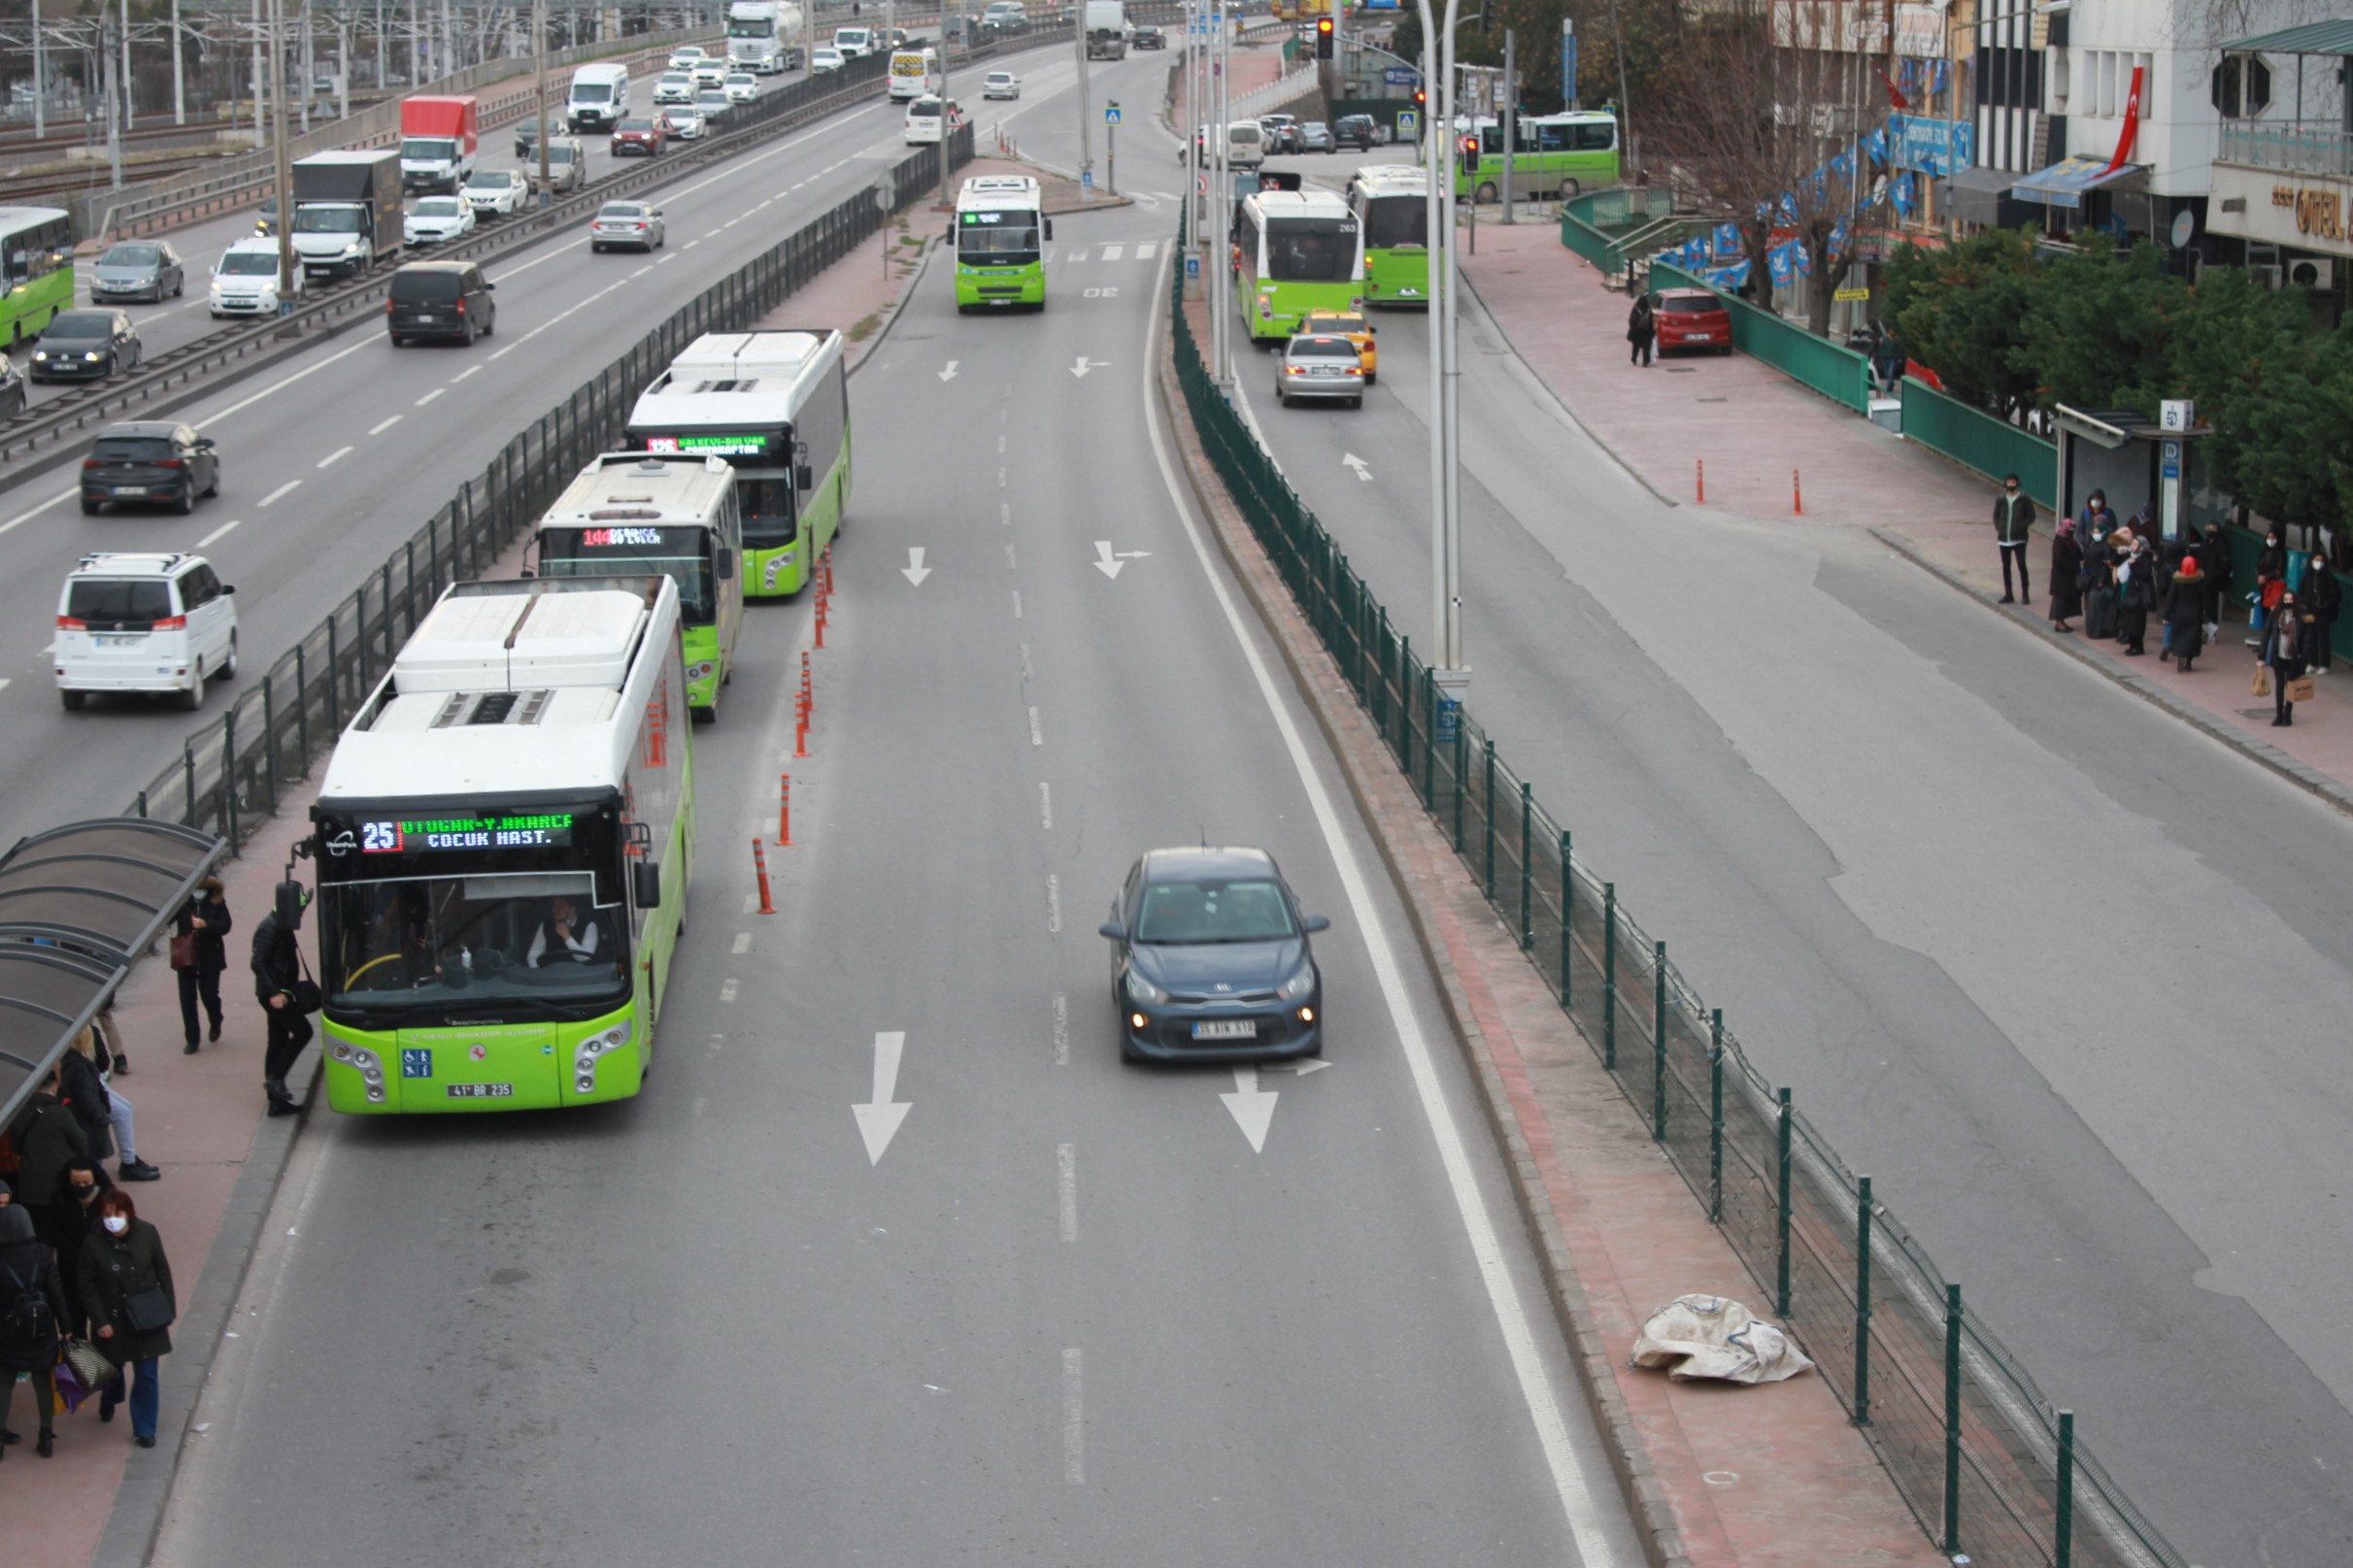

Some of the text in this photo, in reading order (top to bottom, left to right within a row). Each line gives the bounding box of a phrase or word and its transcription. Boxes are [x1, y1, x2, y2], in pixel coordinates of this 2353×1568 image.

[2296, 187, 2345, 241] OTEL
[362, 821, 394, 851] 25
[454, 1084, 510, 1097] 41 BR 235
